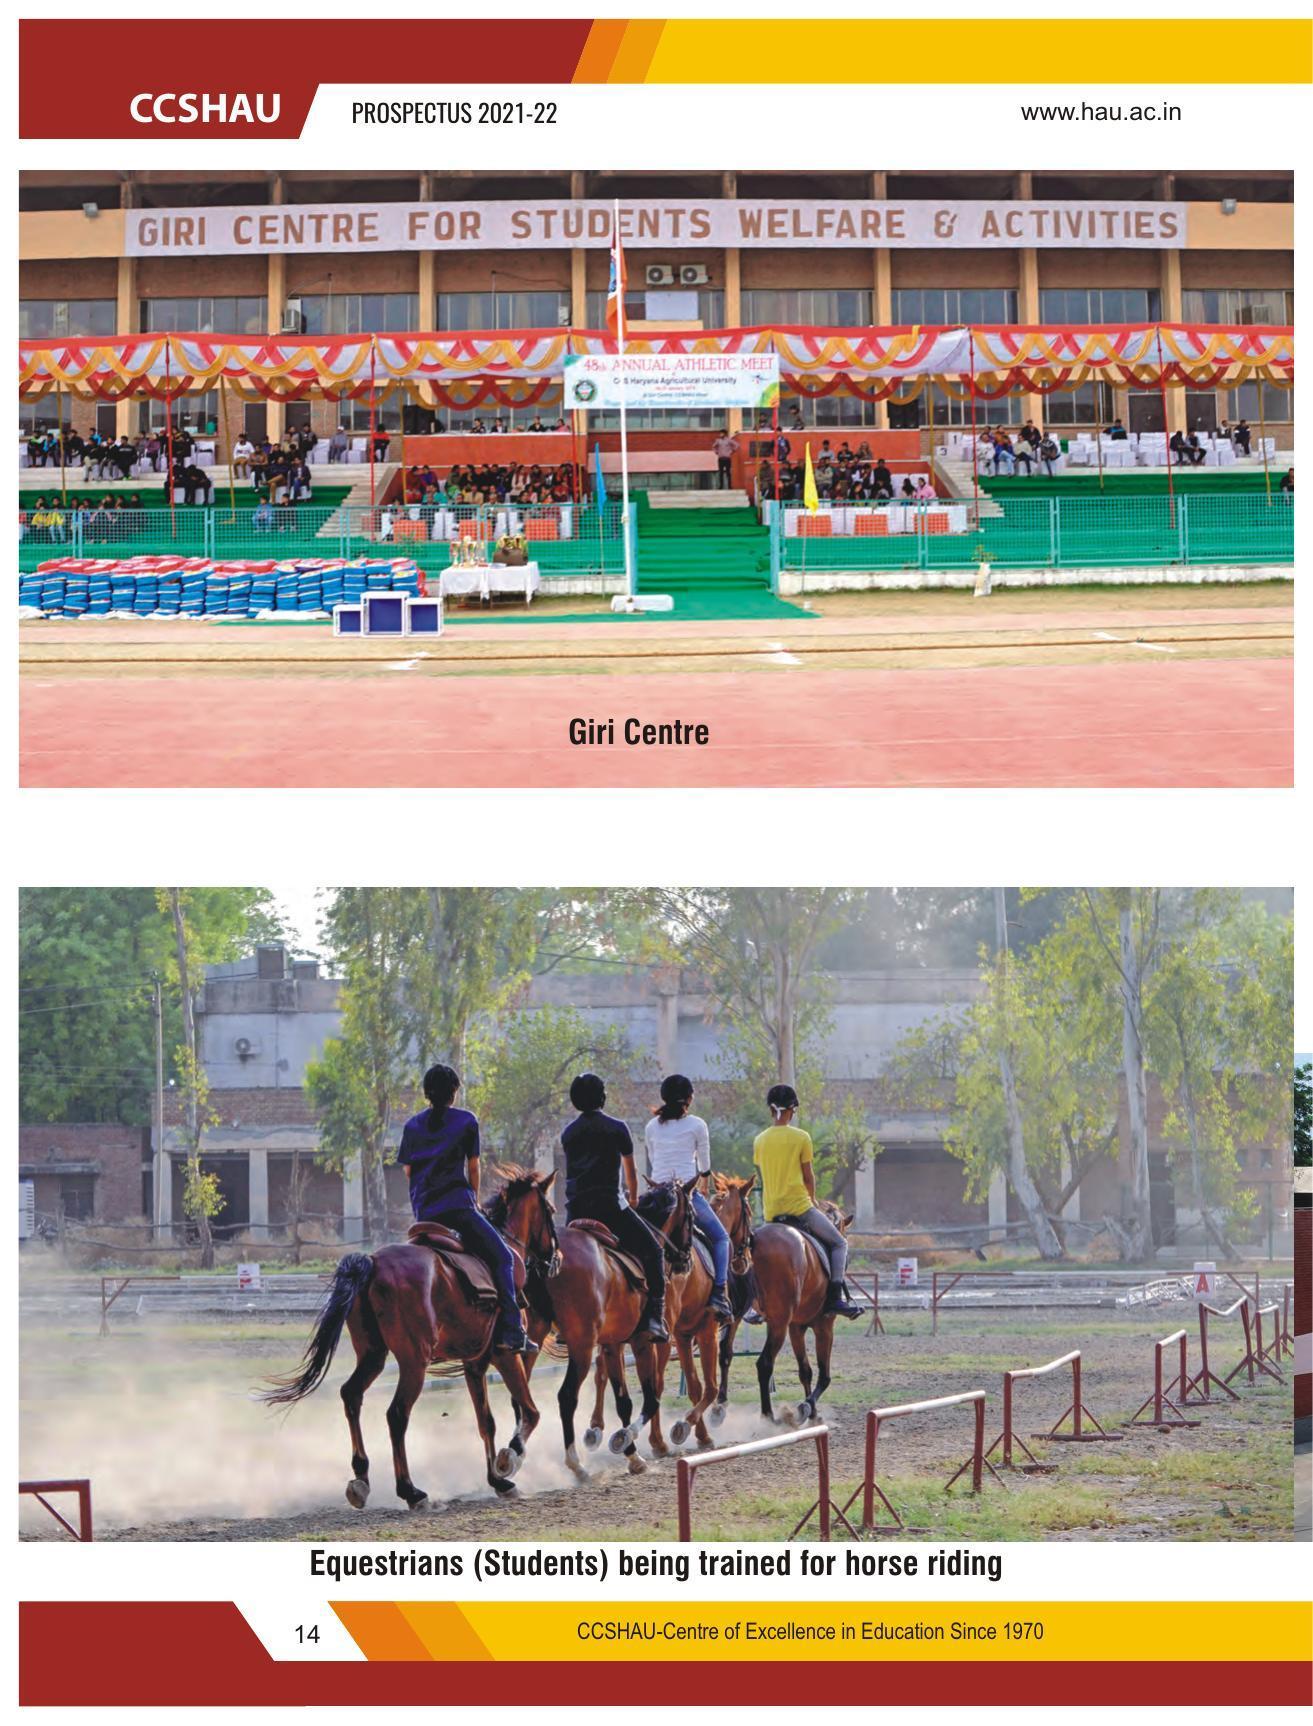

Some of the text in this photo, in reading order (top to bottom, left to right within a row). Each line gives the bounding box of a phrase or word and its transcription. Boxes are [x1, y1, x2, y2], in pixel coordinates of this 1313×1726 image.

[138, 208, 1179, 247] GIRI CENTRE FOR STUDENTS WELFARE & ACTIVITIES
[612, 357, 670, 371] ANNUAL
[674, 357, 737, 370] ATHLETIC
[741, 357, 773, 370] MEET
[630, 377, 659, 386] Haryana
[660, 376, 701, 386] Agricultural
[703, 376, 737, 386] University
[1196, 1272, 1210, 1294] A
